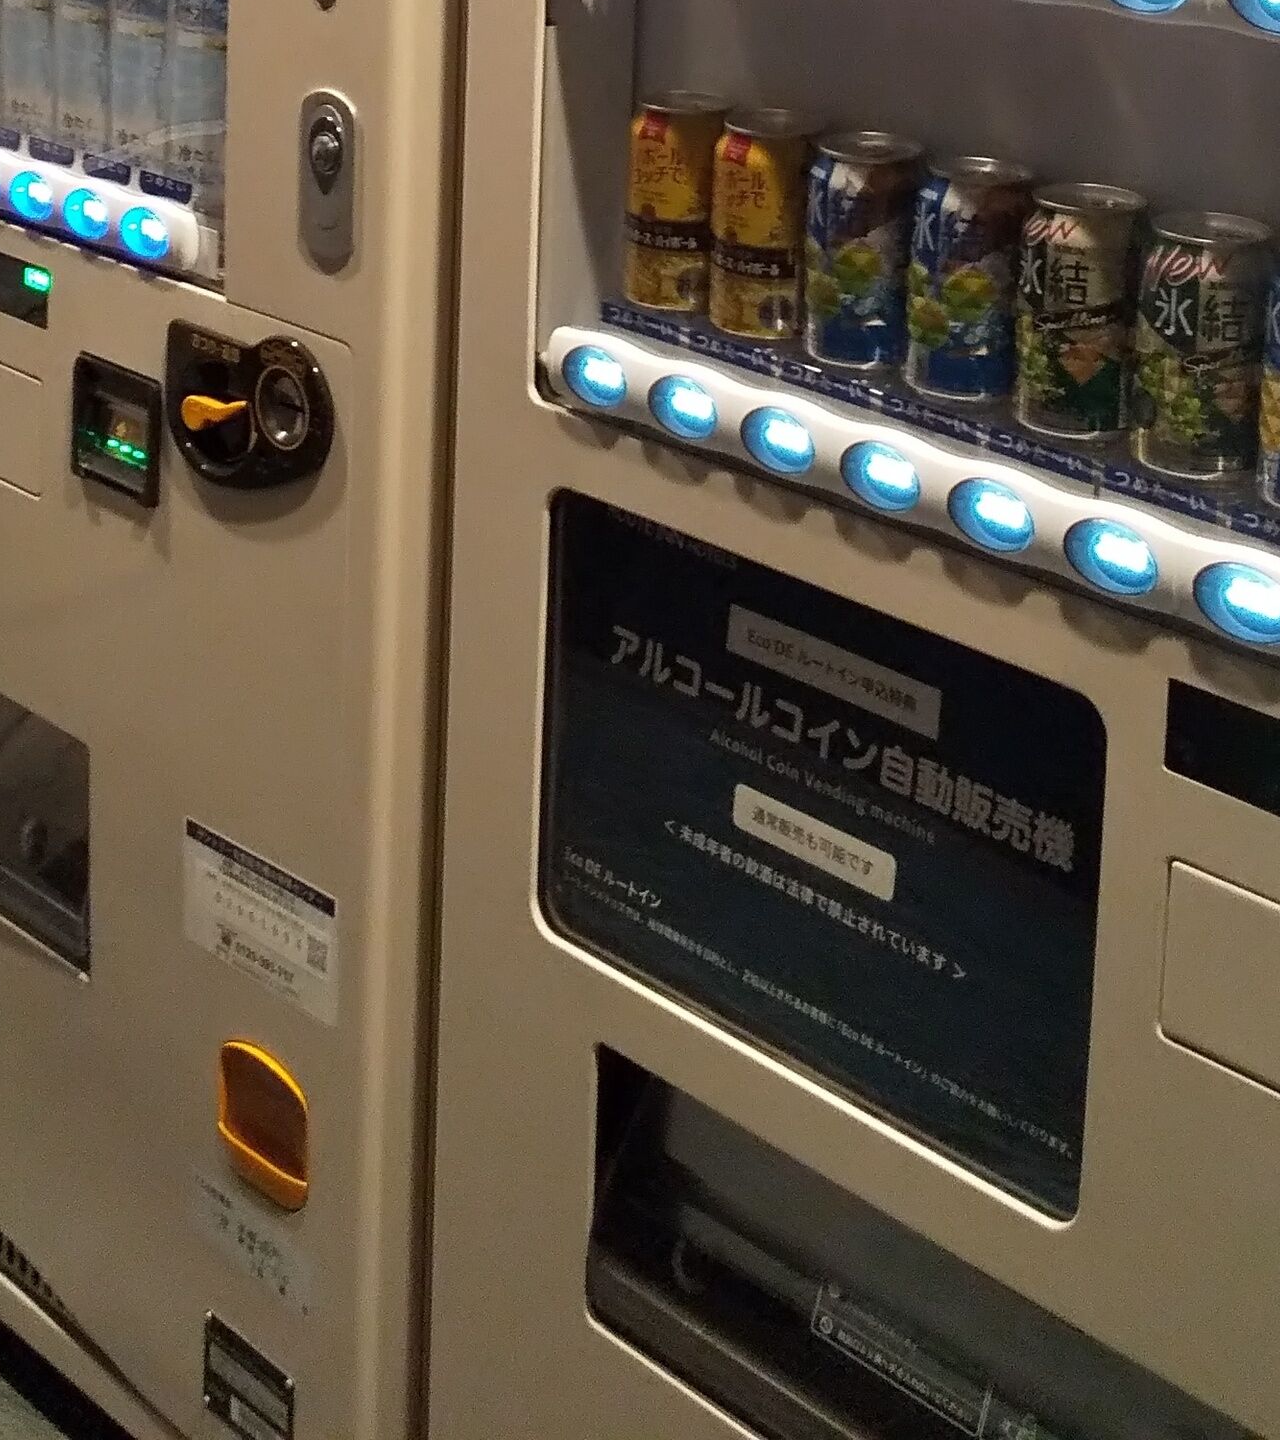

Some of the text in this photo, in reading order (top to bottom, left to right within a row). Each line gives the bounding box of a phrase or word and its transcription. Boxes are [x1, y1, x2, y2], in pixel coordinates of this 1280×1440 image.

[1018, 247, 1091, 306] 氷結
[1153, 287, 1248, 343] 氷結
[610, 624, 1076, 874] アルコールコイン自動販売機
